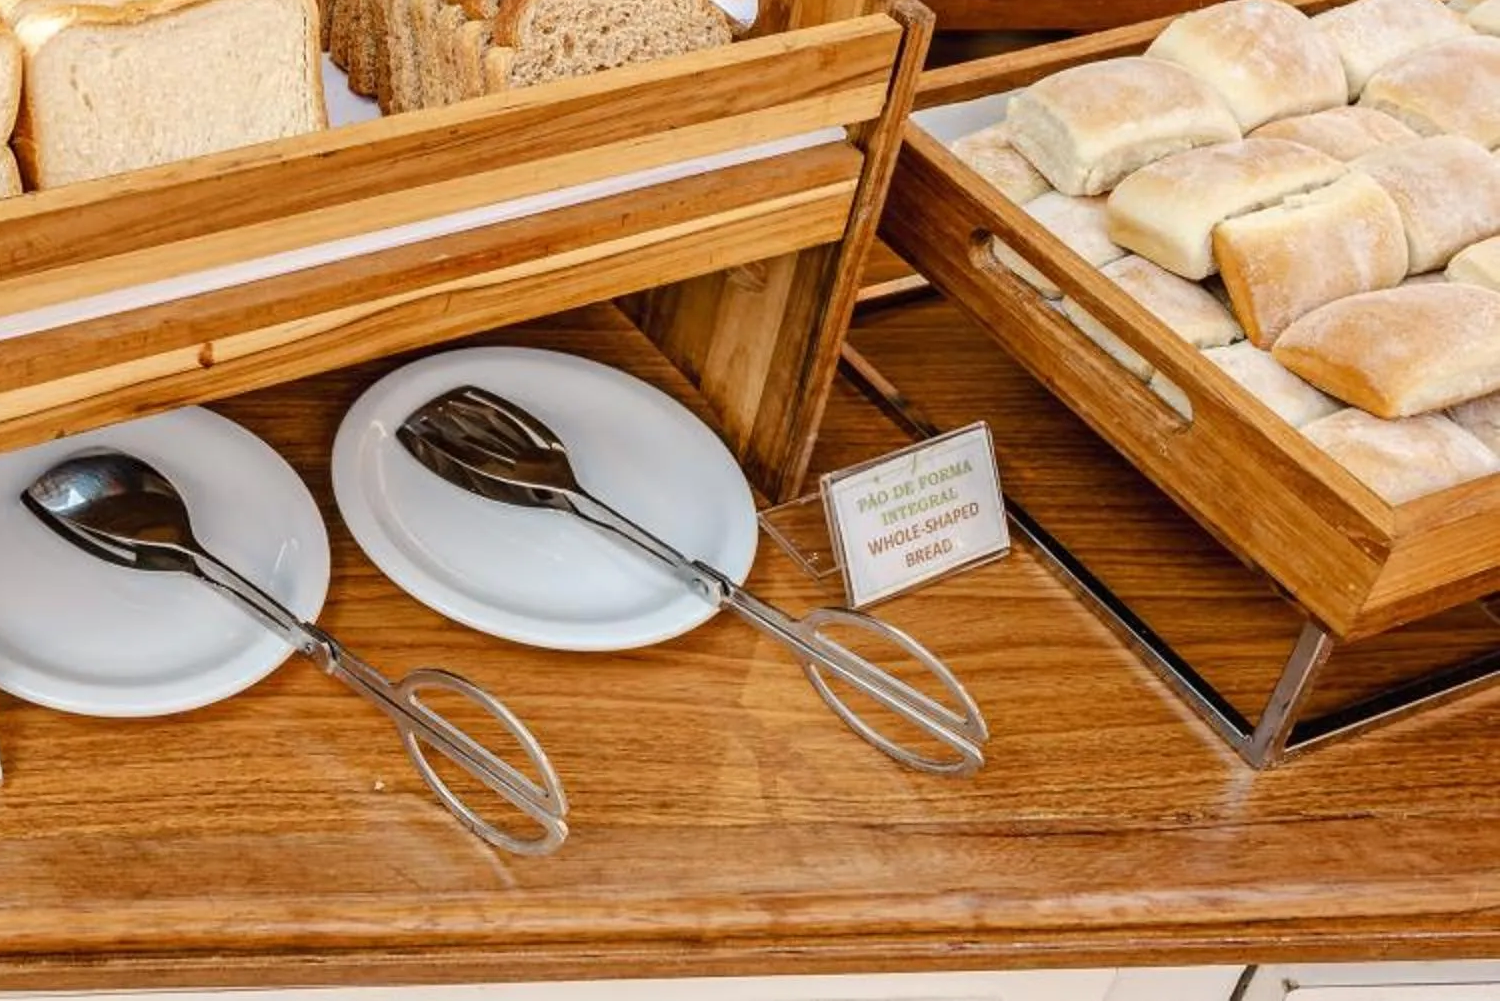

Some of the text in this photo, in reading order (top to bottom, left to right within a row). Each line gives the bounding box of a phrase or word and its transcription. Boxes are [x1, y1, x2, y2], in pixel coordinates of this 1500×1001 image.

[856, 458, 973, 514] PÃO DE FORMA
[880, 487, 959, 526] INTEGRAL
[867, 502, 980, 556] WHOLE-SHAPED
[905, 538, 954, 568] BREAD
